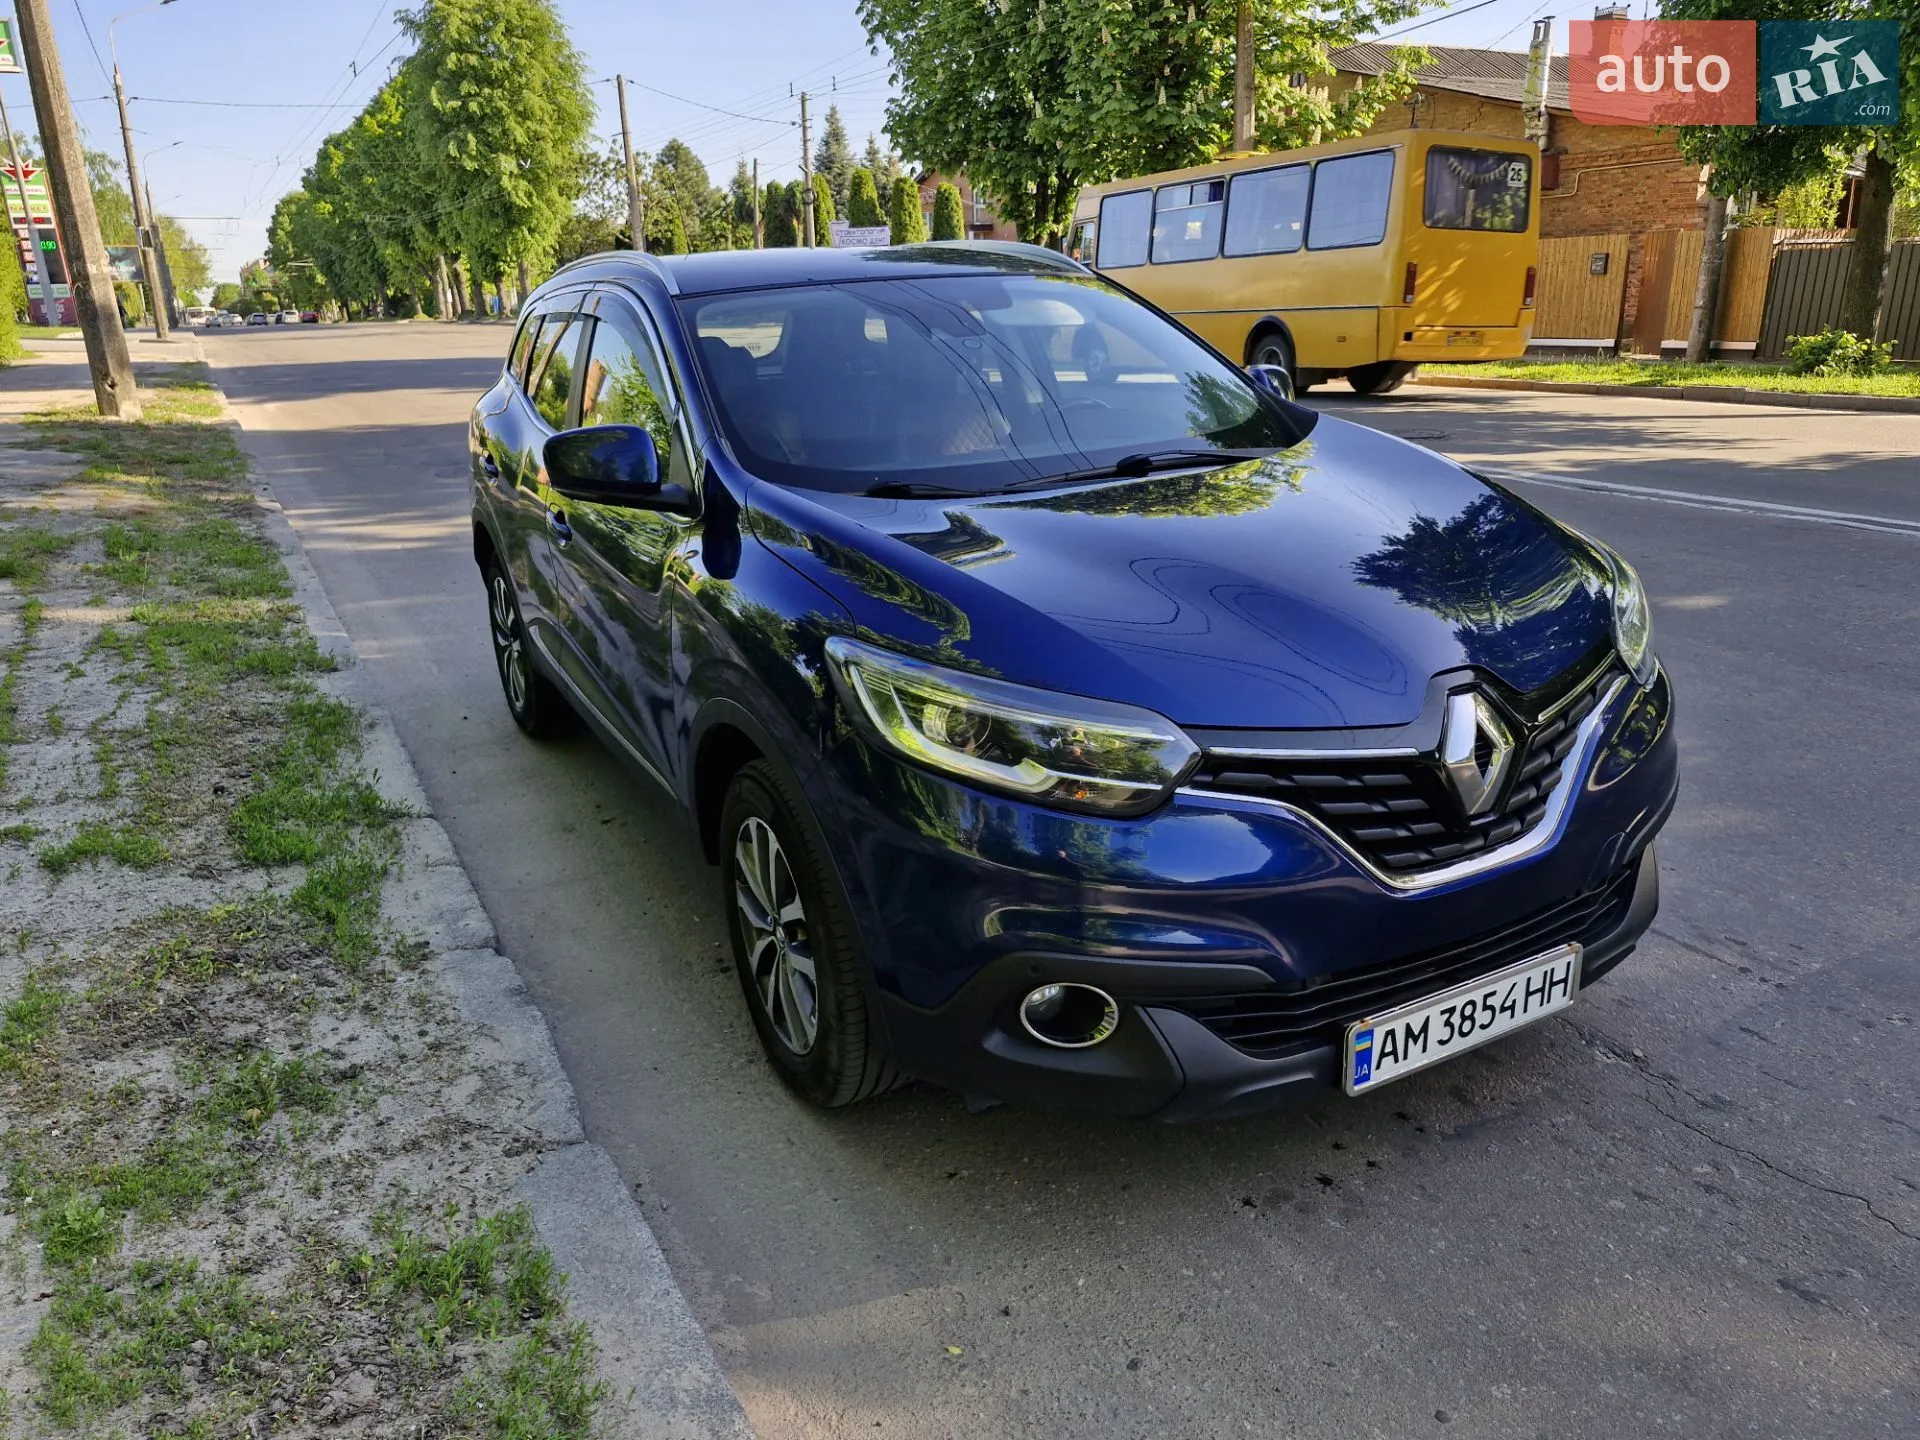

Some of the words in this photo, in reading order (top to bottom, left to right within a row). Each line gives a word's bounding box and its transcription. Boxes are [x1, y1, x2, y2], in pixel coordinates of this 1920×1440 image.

[1510, 167, 1522, 182] 26
[841, 237, 868, 245] КОСМО
[870, 237, 886, 245] ДЕНТ
[1375, 1014, 1431, 1071] AM
[1436, 981, 1518, 1047] 3854
[1523, 960, 1572, 1015] HH
